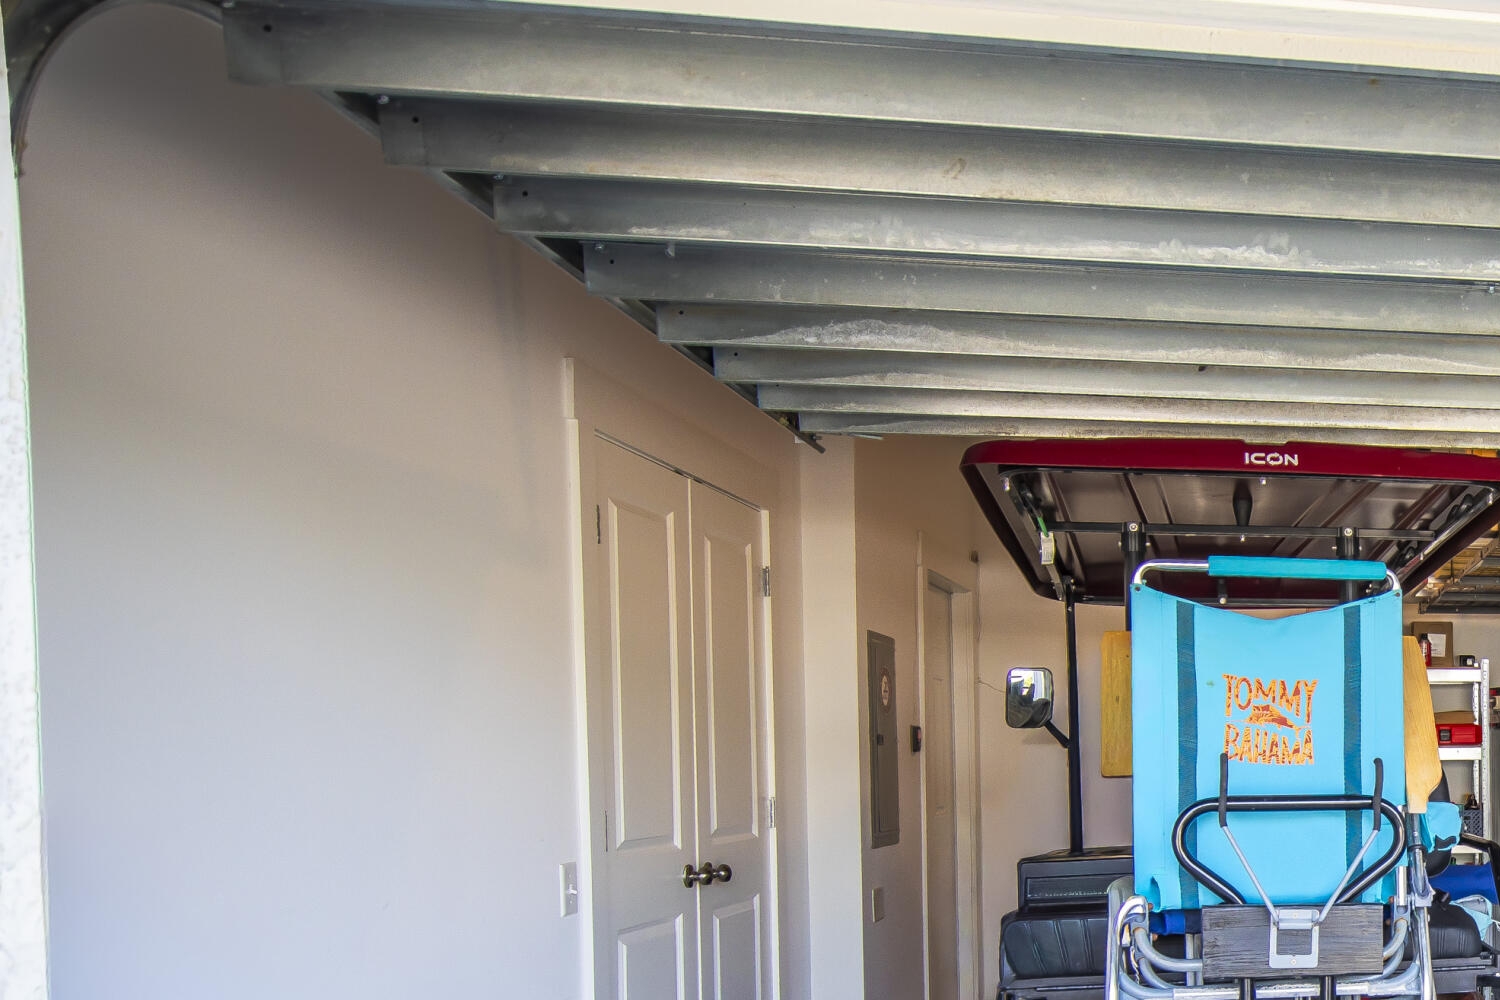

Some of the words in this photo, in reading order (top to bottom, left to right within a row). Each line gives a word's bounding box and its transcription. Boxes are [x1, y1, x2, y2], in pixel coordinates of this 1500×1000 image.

[1244, 452, 1299, 466] ICON
[1222, 673, 1319, 724] TOMMY
[1223, 723, 1315, 765] BAHAMA
